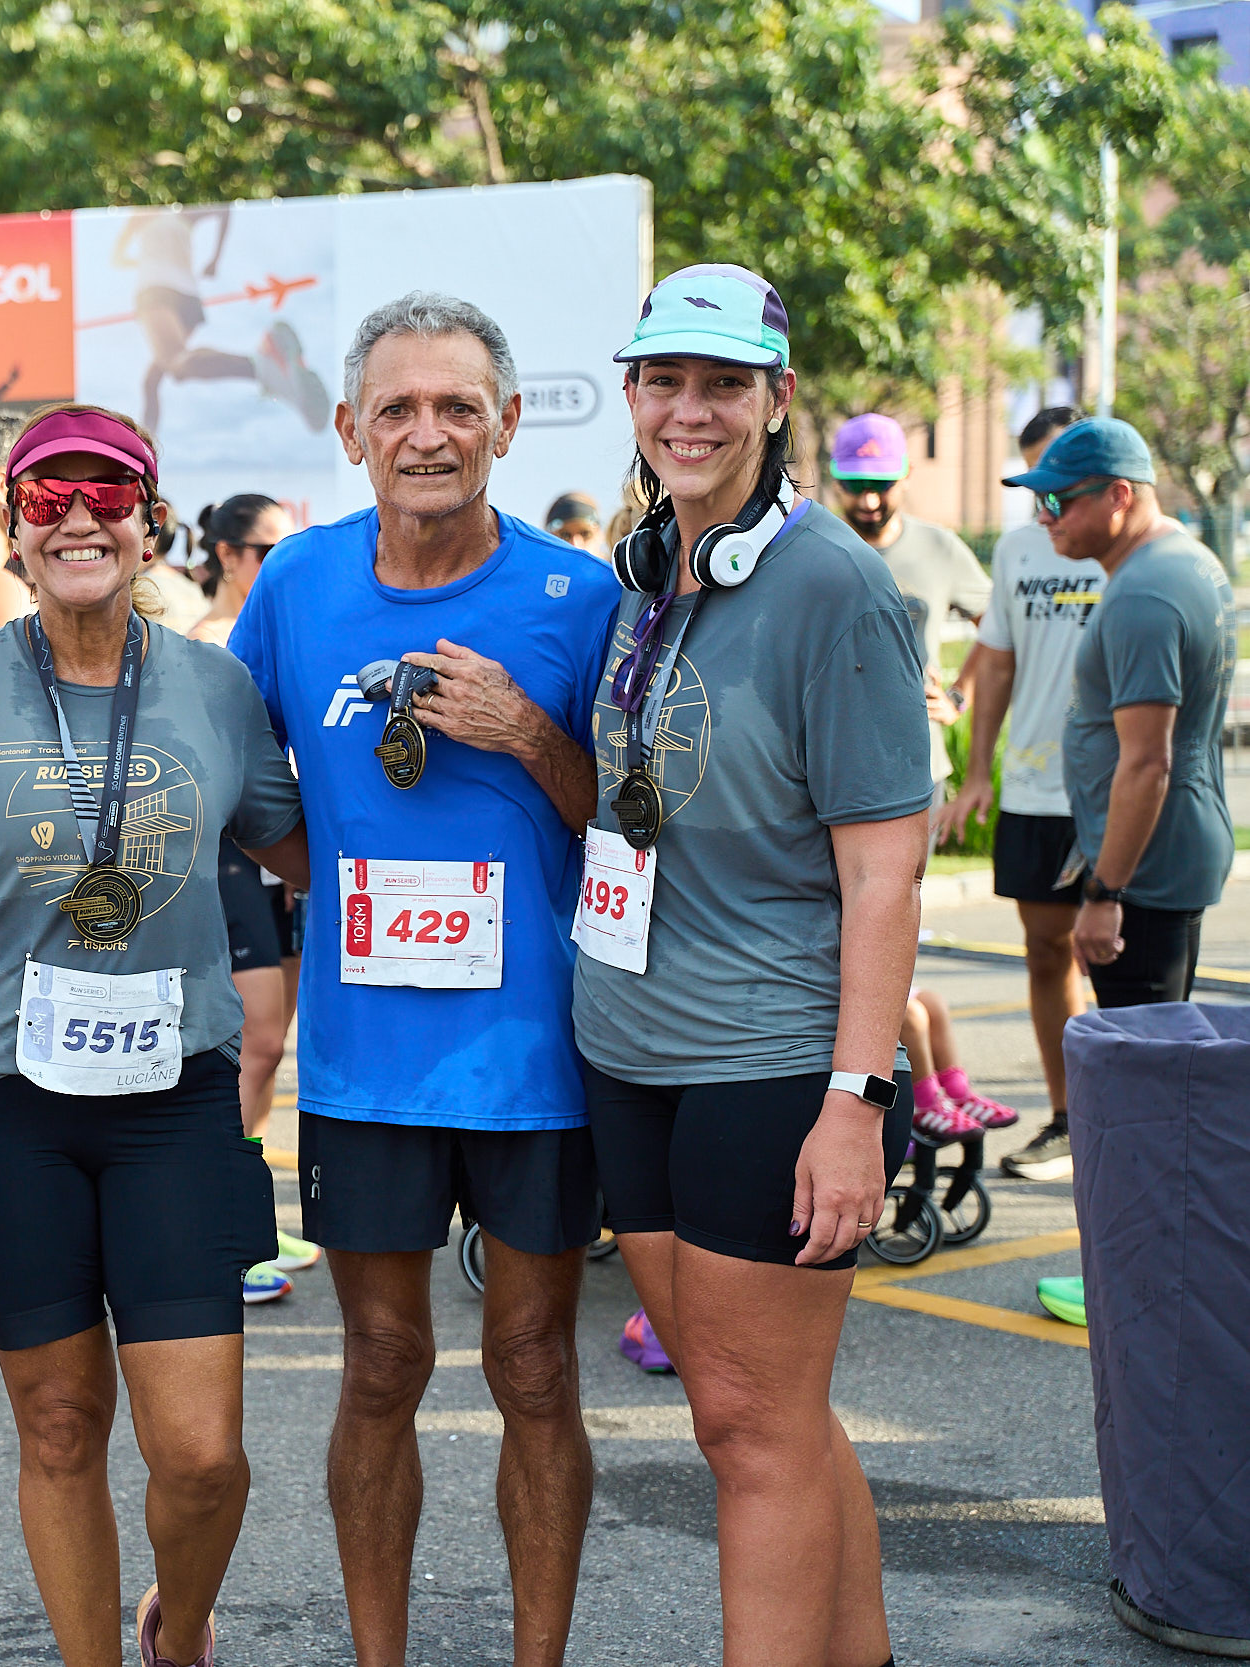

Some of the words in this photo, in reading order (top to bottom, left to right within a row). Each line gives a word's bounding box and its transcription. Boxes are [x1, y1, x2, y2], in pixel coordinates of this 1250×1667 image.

[523, 385, 582, 412] RIES
[1014, 576, 1098, 596] NIGHT
[398, 673, 407, 696] CORRE
[118, 715, 127, 739] ENTENDE
[115, 740, 123, 759] CORRE
[15, 855, 51, 863] SHOPPING
[52, 853, 81, 861] VITÓRIA
[584, 876, 628, 920] 493
[354, 903, 366, 943] 10KM
[386, 910, 470, 944] 429
[32, 1012, 46, 1046] 5KM
[62, 1018, 161, 1054] 5515
[117, 1068, 177, 1086] LUCIANE
